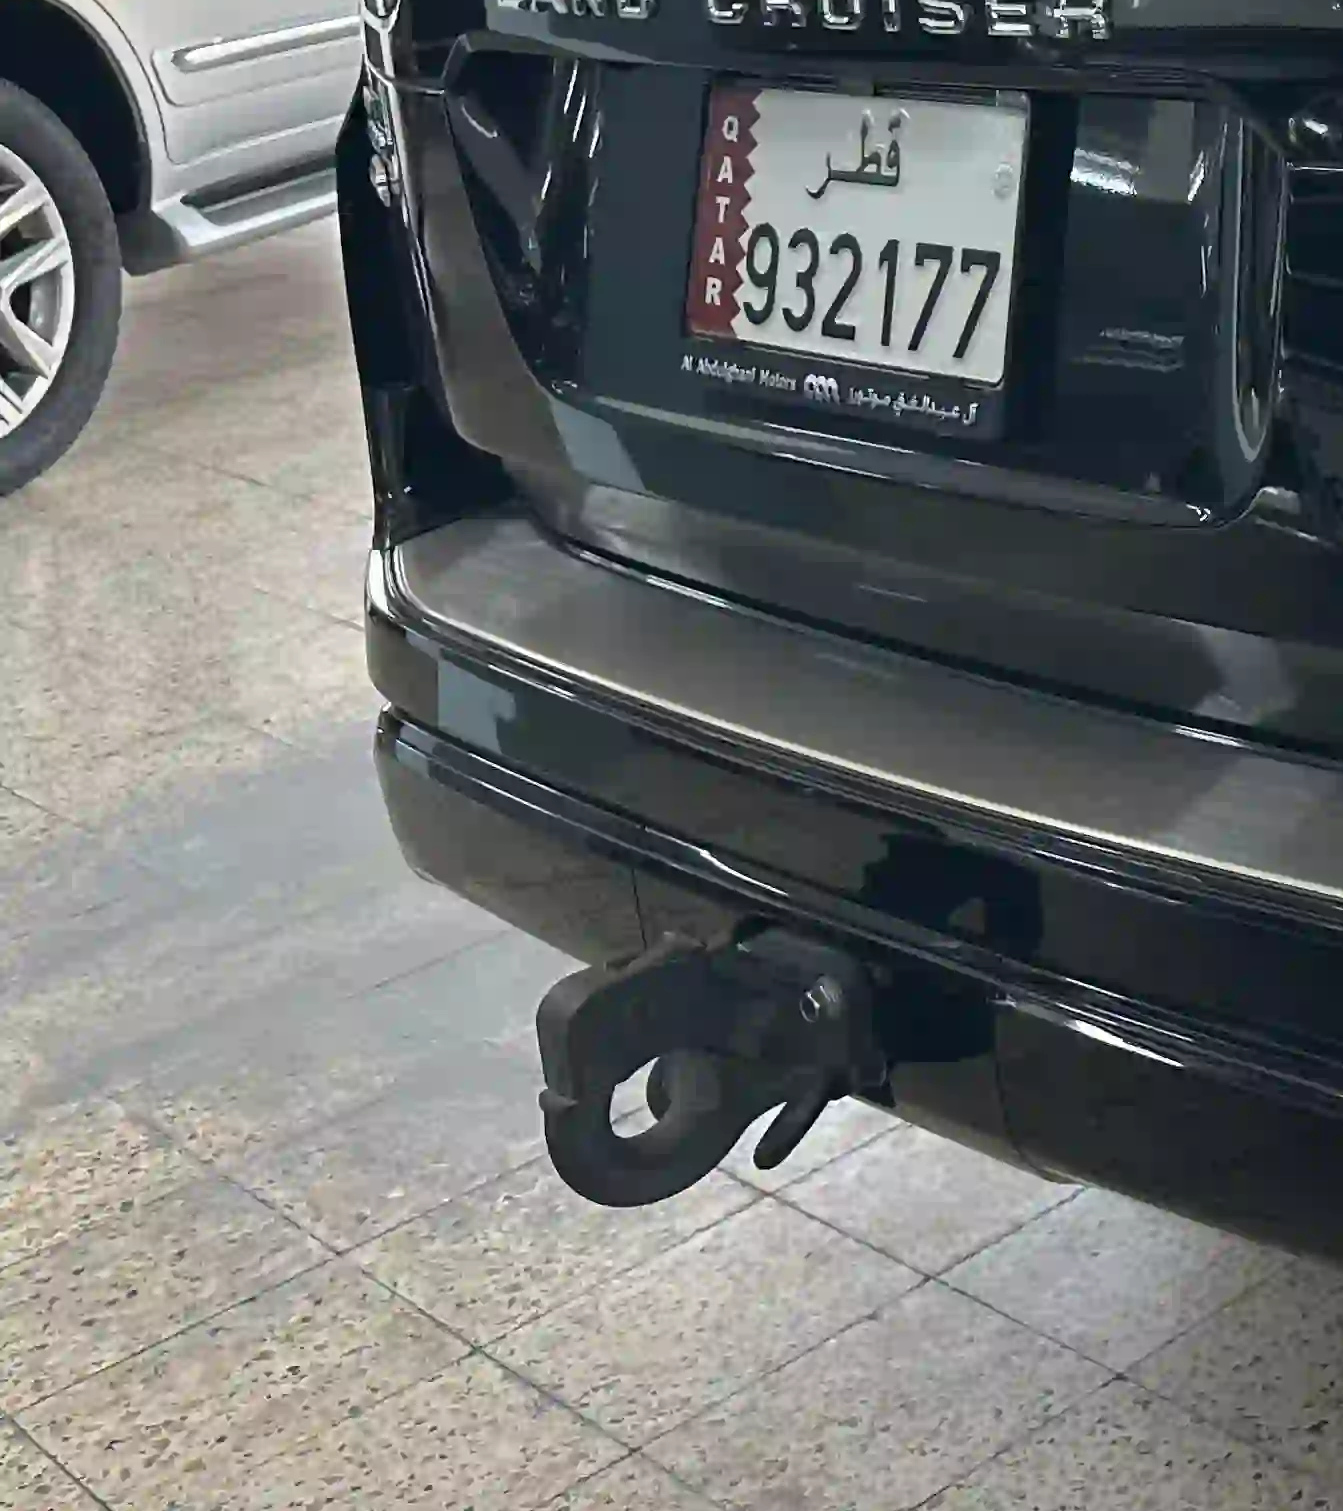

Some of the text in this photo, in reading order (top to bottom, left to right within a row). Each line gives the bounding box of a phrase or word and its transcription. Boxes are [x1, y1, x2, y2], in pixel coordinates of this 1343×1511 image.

[704, 115, 740, 307] QATAR
[804, 107, 911, 200] قطر
[742, 221, 1002, 359] 932177
[759, 368, 797, 392] Motors
